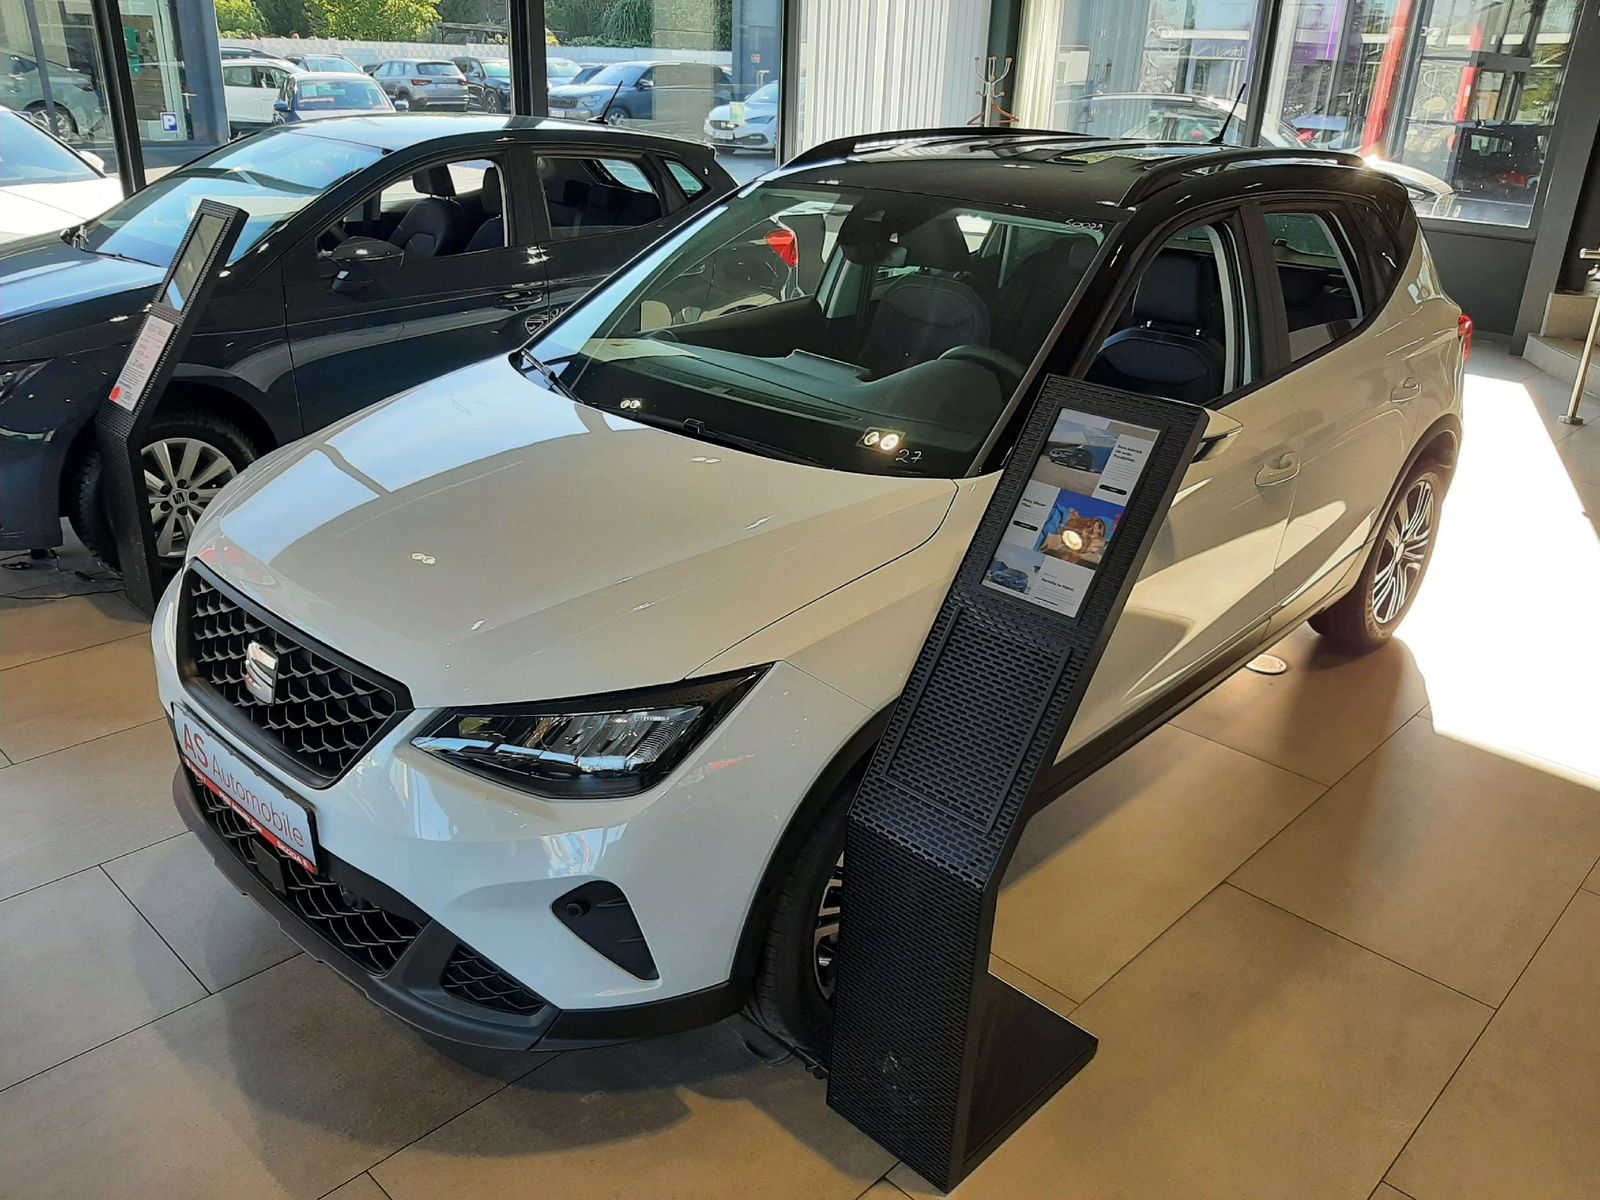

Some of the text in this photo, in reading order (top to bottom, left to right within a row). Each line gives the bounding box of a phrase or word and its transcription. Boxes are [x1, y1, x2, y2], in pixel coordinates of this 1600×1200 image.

[163, 115, 175, 130] P
[183, 723, 209, 769] AS
[212, 754, 304, 848] Automobile
